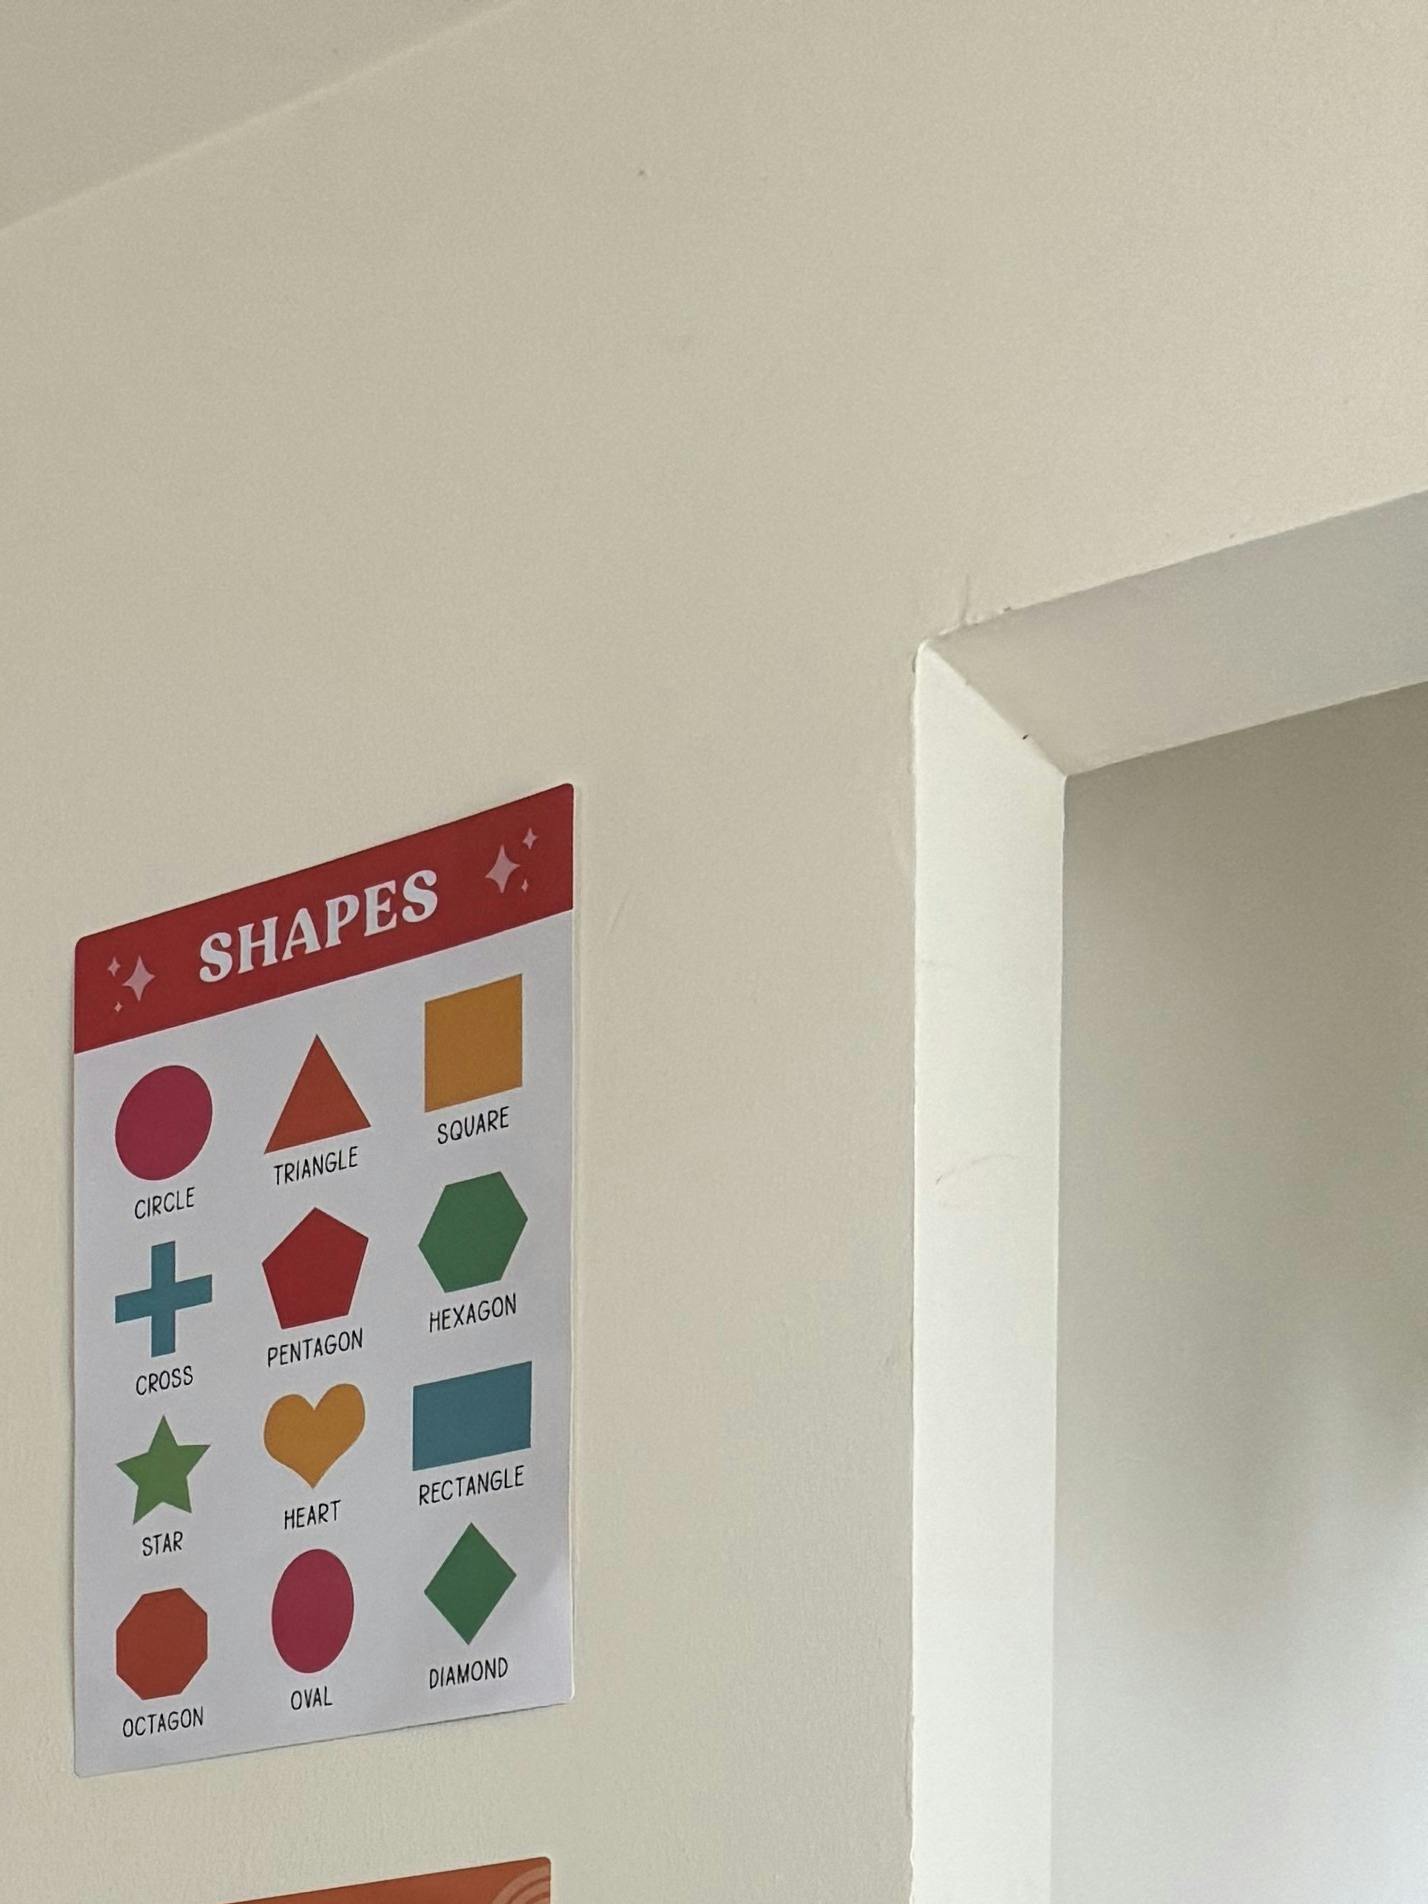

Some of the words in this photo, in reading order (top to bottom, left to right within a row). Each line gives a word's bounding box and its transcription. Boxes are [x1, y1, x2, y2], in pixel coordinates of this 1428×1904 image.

[199, 869, 438, 983] SHAPES
[437, 1105, 510, 1145] SQUARE
[273, 1145, 358, 1186] TRIANGLE
[134, 1186, 196, 1220] CIRCLE
[429, 1292, 517, 1333] HEXAGON
[267, 1327, 363, 1368] PENTAGON
[135, 1365, 194, 1396] CROSS
[419, 1464, 525, 1506] RECTANGLE
[284, 1499, 342, 1530] HEART
[142, 1530, 184, 1557] STAR
[429, 1656, 509, 1690] DIAMOND
[290, 1685, 333, 1711] OVAL
[122, 1706, 204, 1738] OCTAGON
